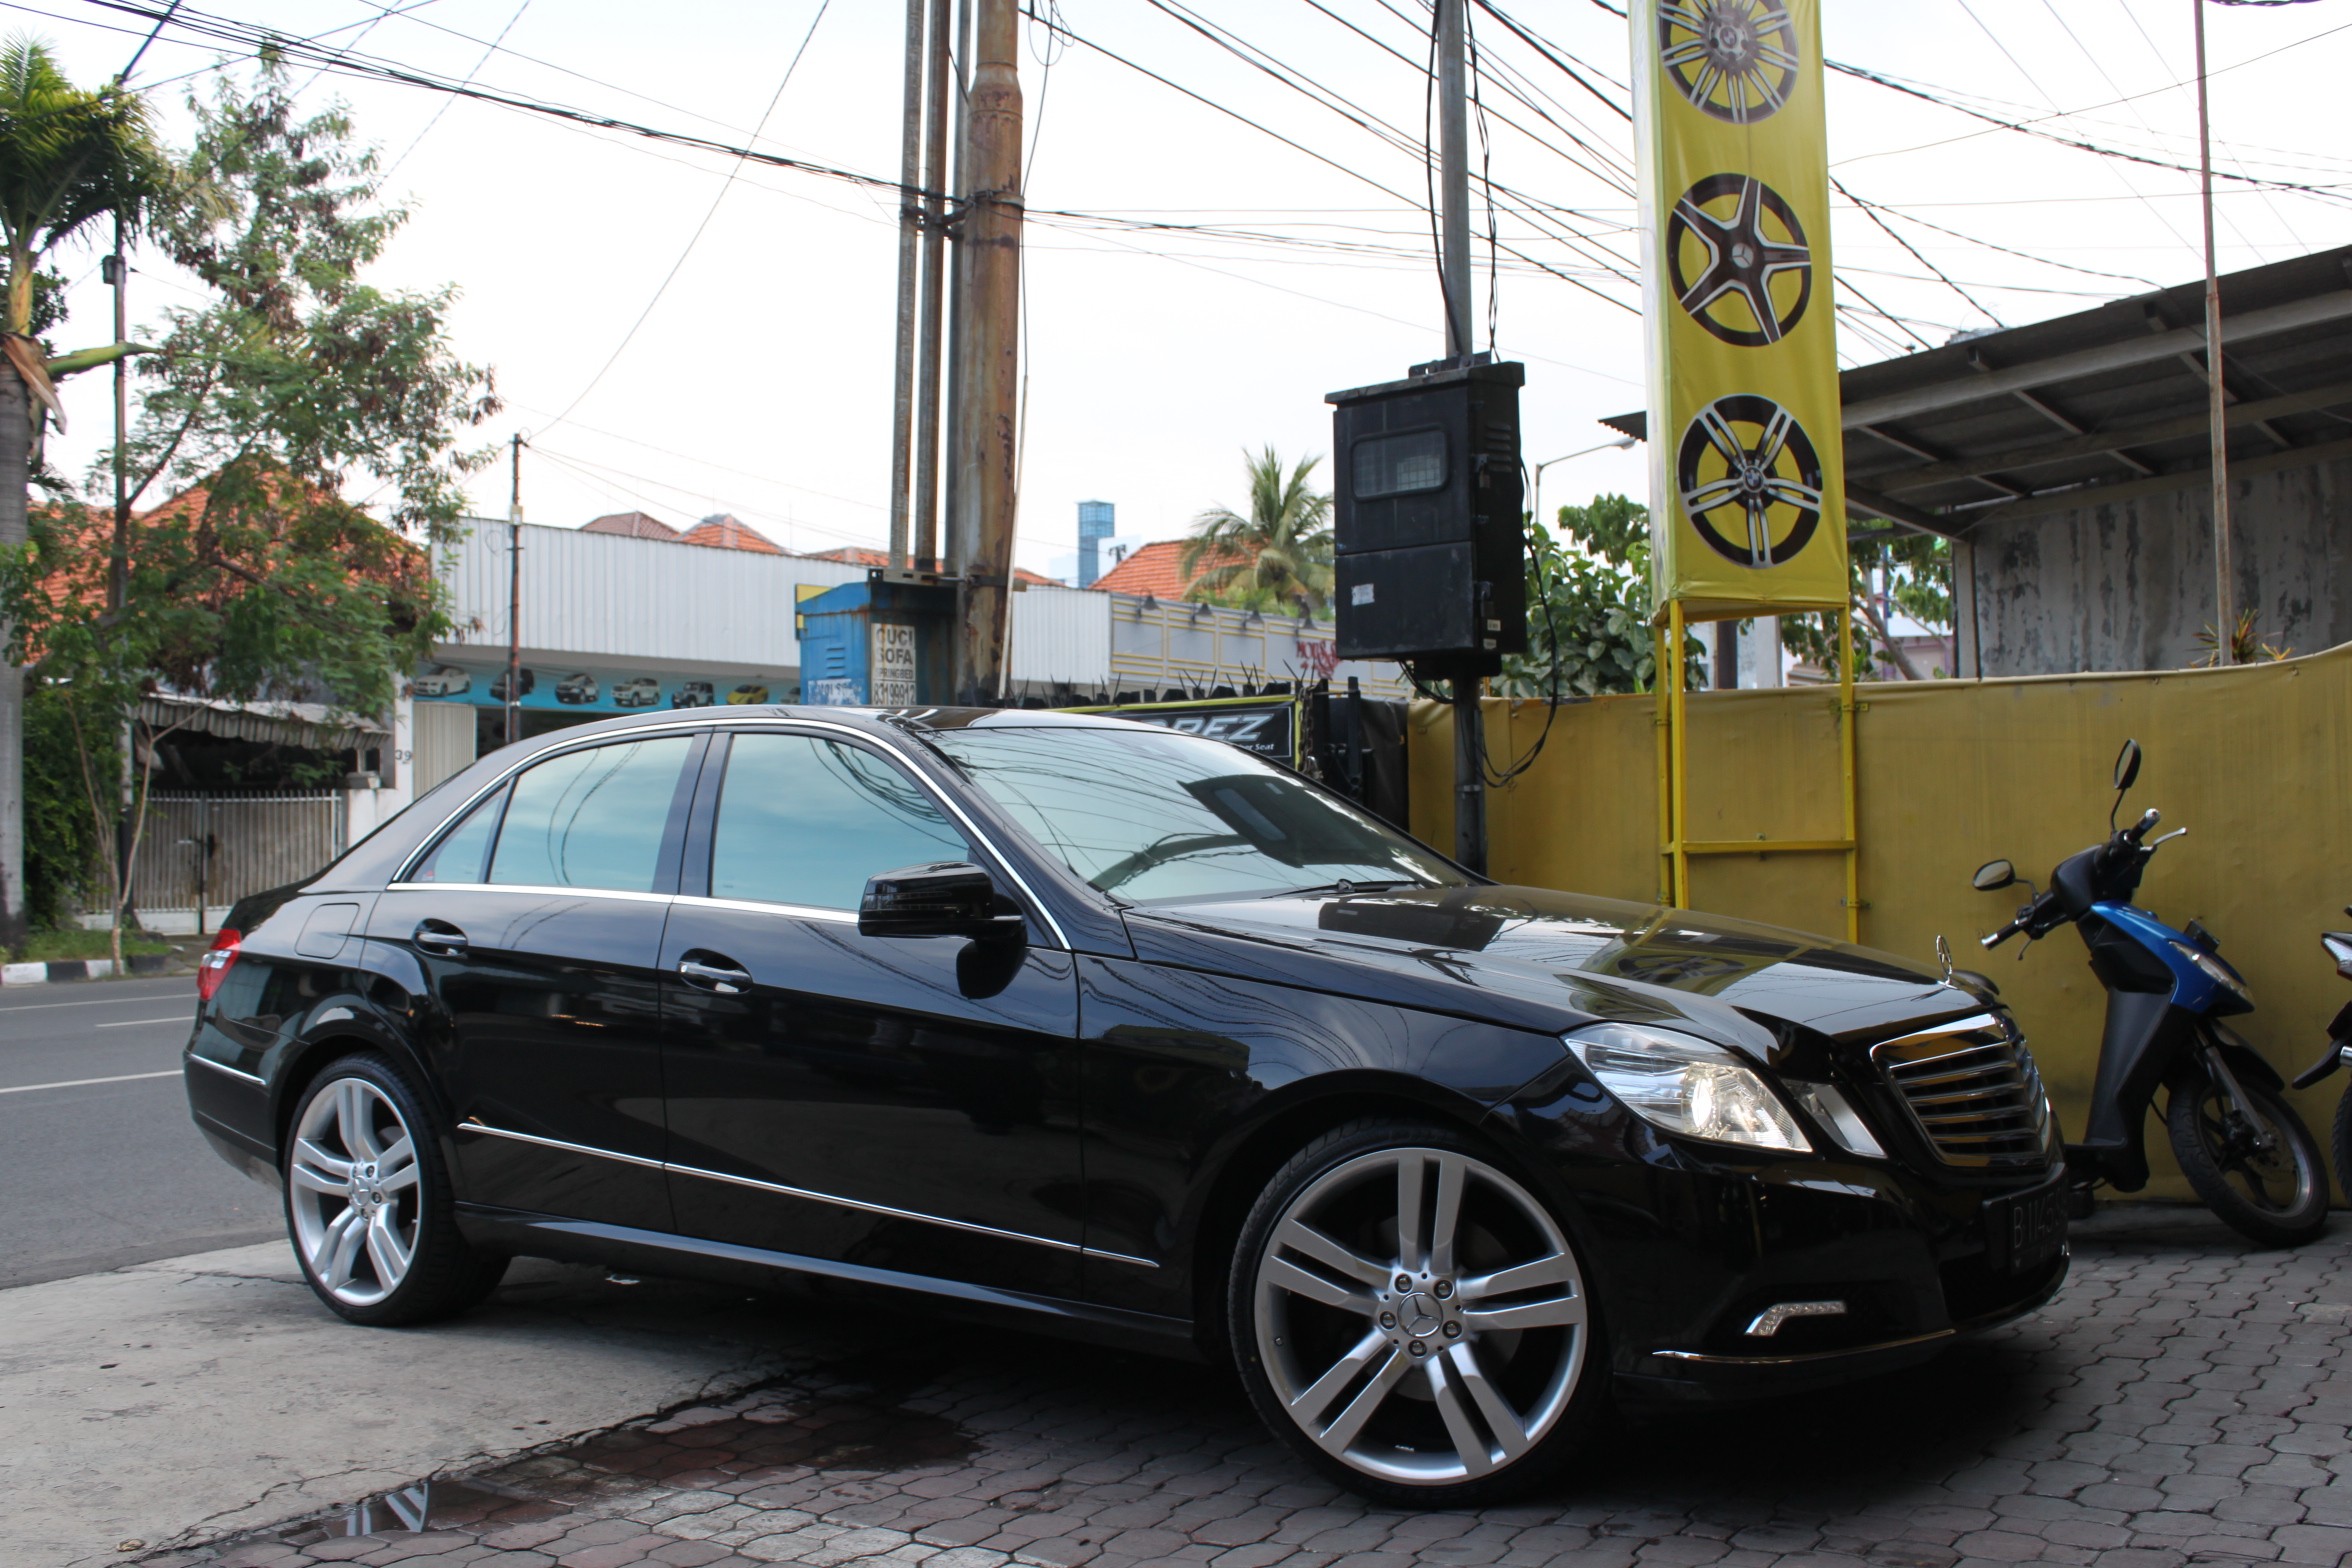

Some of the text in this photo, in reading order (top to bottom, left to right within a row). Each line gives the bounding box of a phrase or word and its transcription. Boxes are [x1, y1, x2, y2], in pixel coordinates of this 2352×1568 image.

[876, 627, 913, 646] CUCI
[876, 648, 914, 665] SOFA
[2013, 1206, 2023, 1249] B
